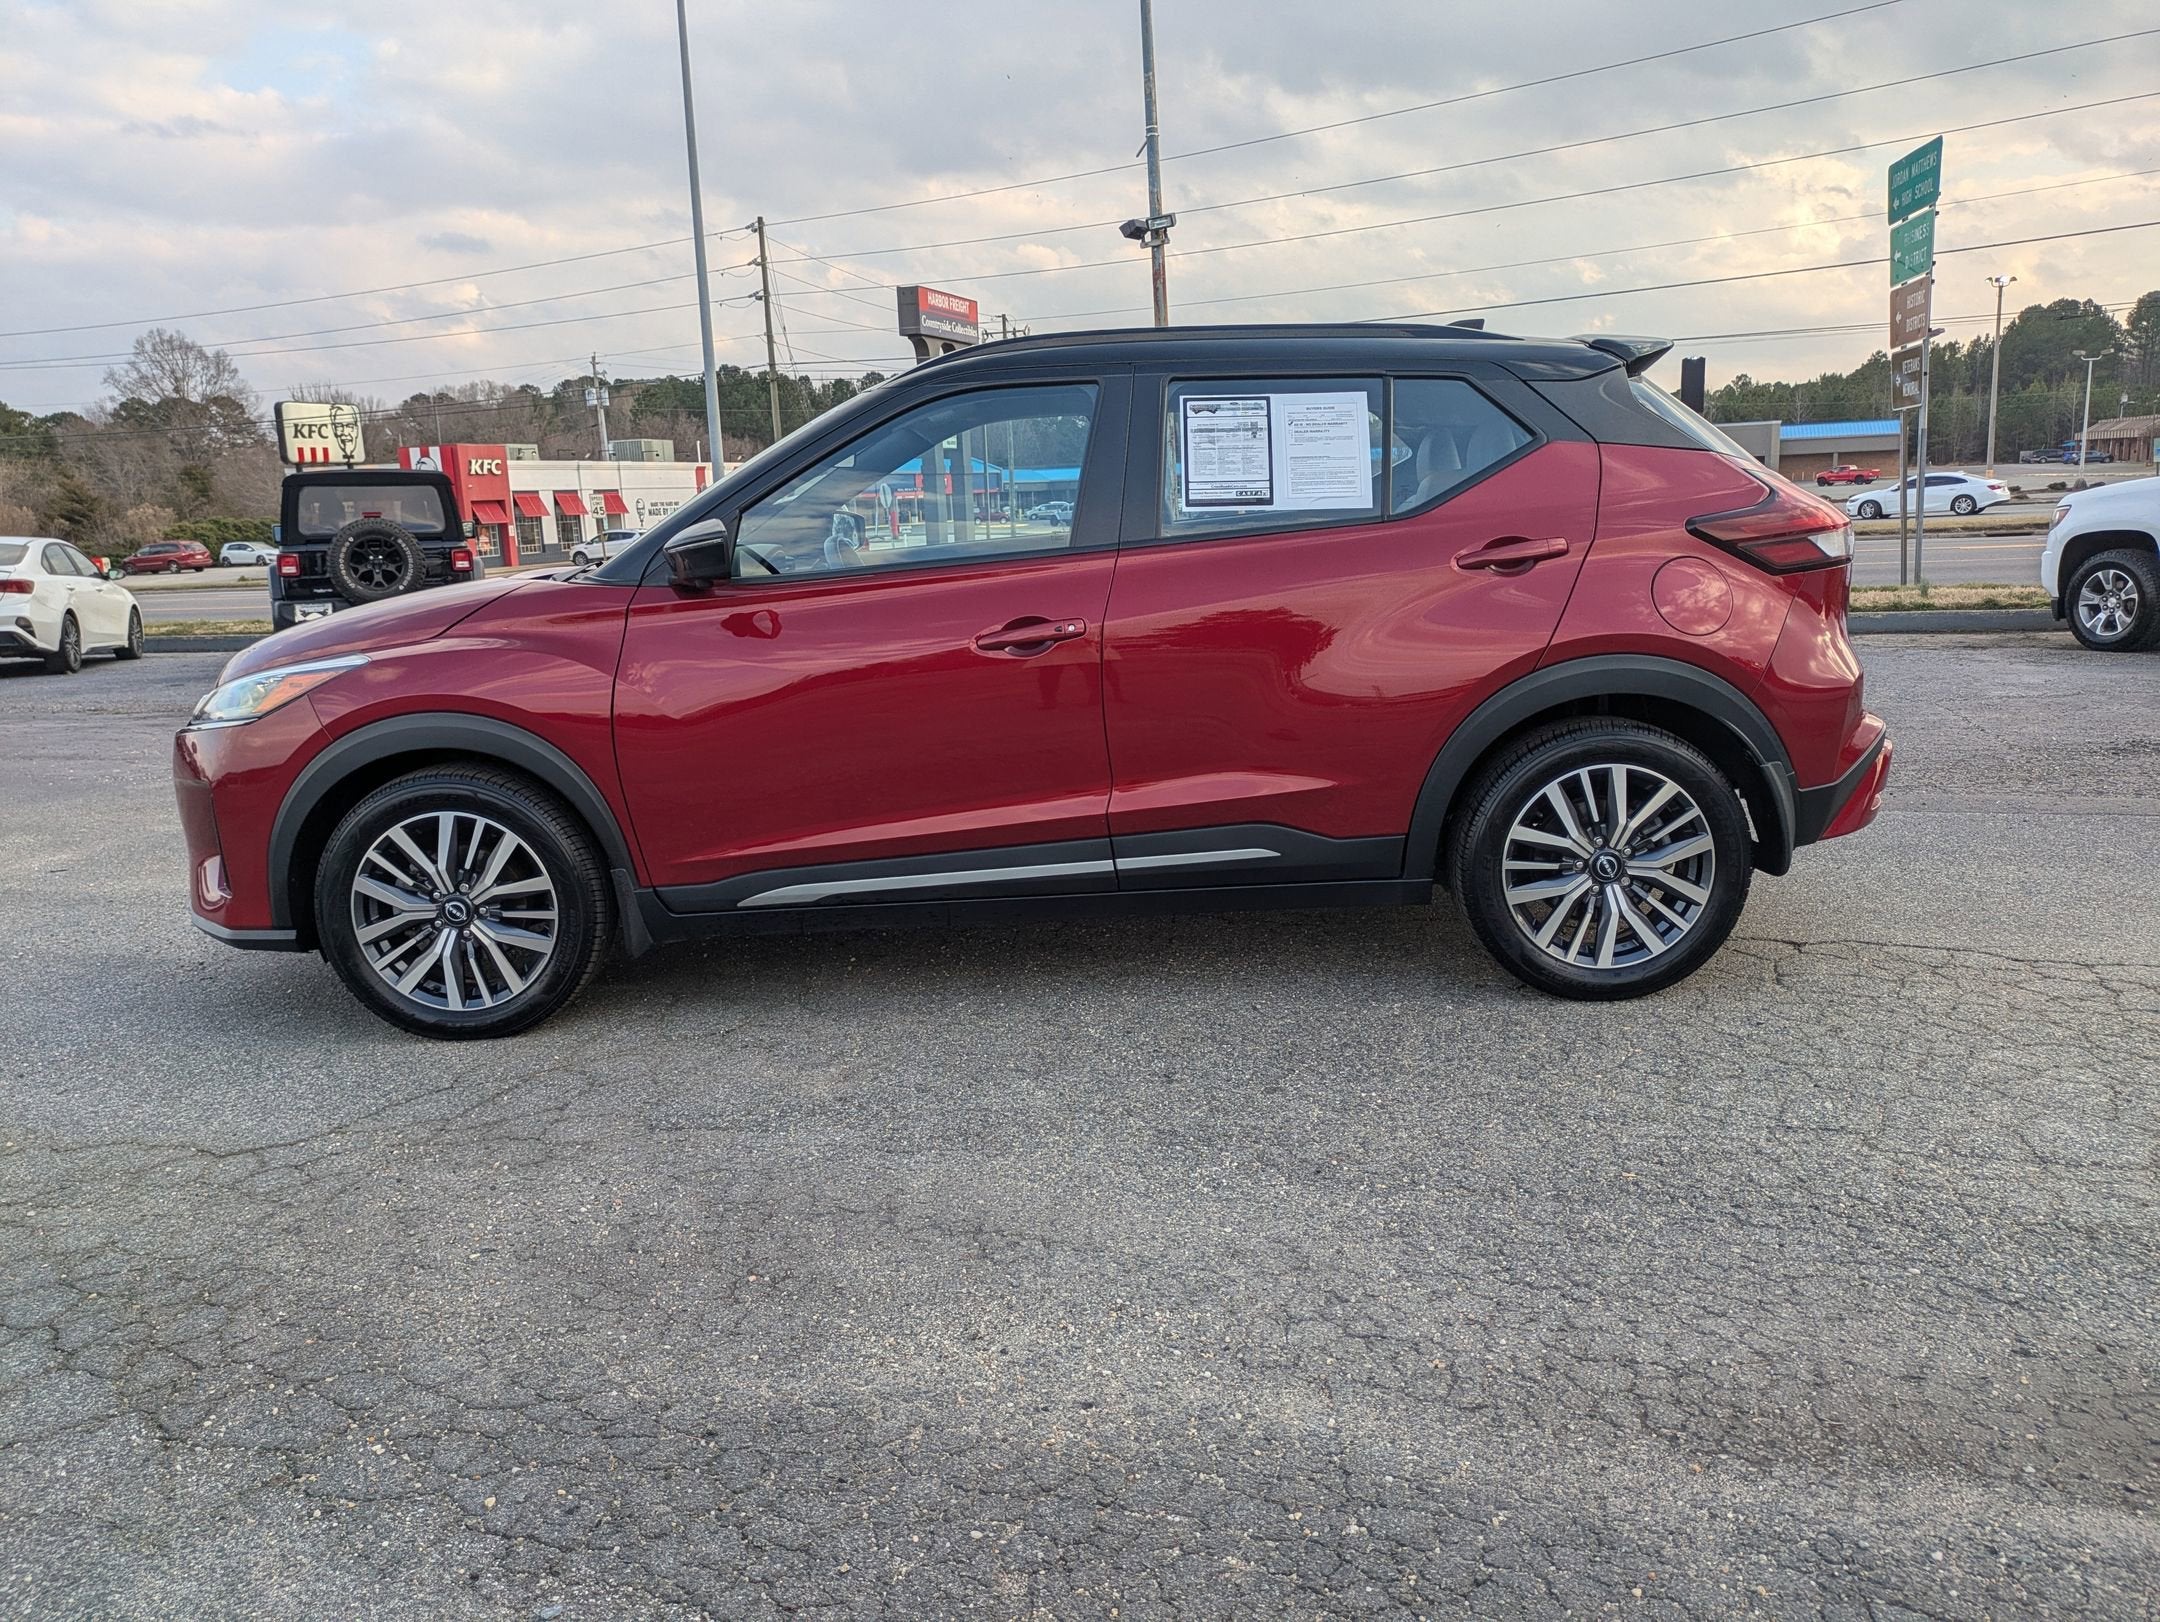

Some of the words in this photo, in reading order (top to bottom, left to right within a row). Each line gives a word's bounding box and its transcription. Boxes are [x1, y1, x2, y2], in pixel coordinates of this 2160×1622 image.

[1891, 166, 1910, 190] JORDAN
[1911, 151, 1937, 177] MATTHEWS
[1901, 188, 1913, 207] HIGH
[1914, 178, 1934, 199] SCHOOL
[927, 291, 949, 309] HARBOR
[949, 296, 970, 314] FREIGHT
[1906, 290, 1926, 310] HISTORIC
[921, 314, 952, 333] Countryside
[952, 321, 977, 337] Collectibles
[1906, 313, 1926, 333] DISTRICTS
[1902, 357, 1921, 375] VETERANS
[1902, 381, 1920, 398] MEMORIAL
[293, 423, 329, 439] KFC
[469, 458, 502, 476] KFC
[593, 506, 605, 516] 45
[648, 508, 662, 516] MADE
[662, 507, 669, 516] BY
